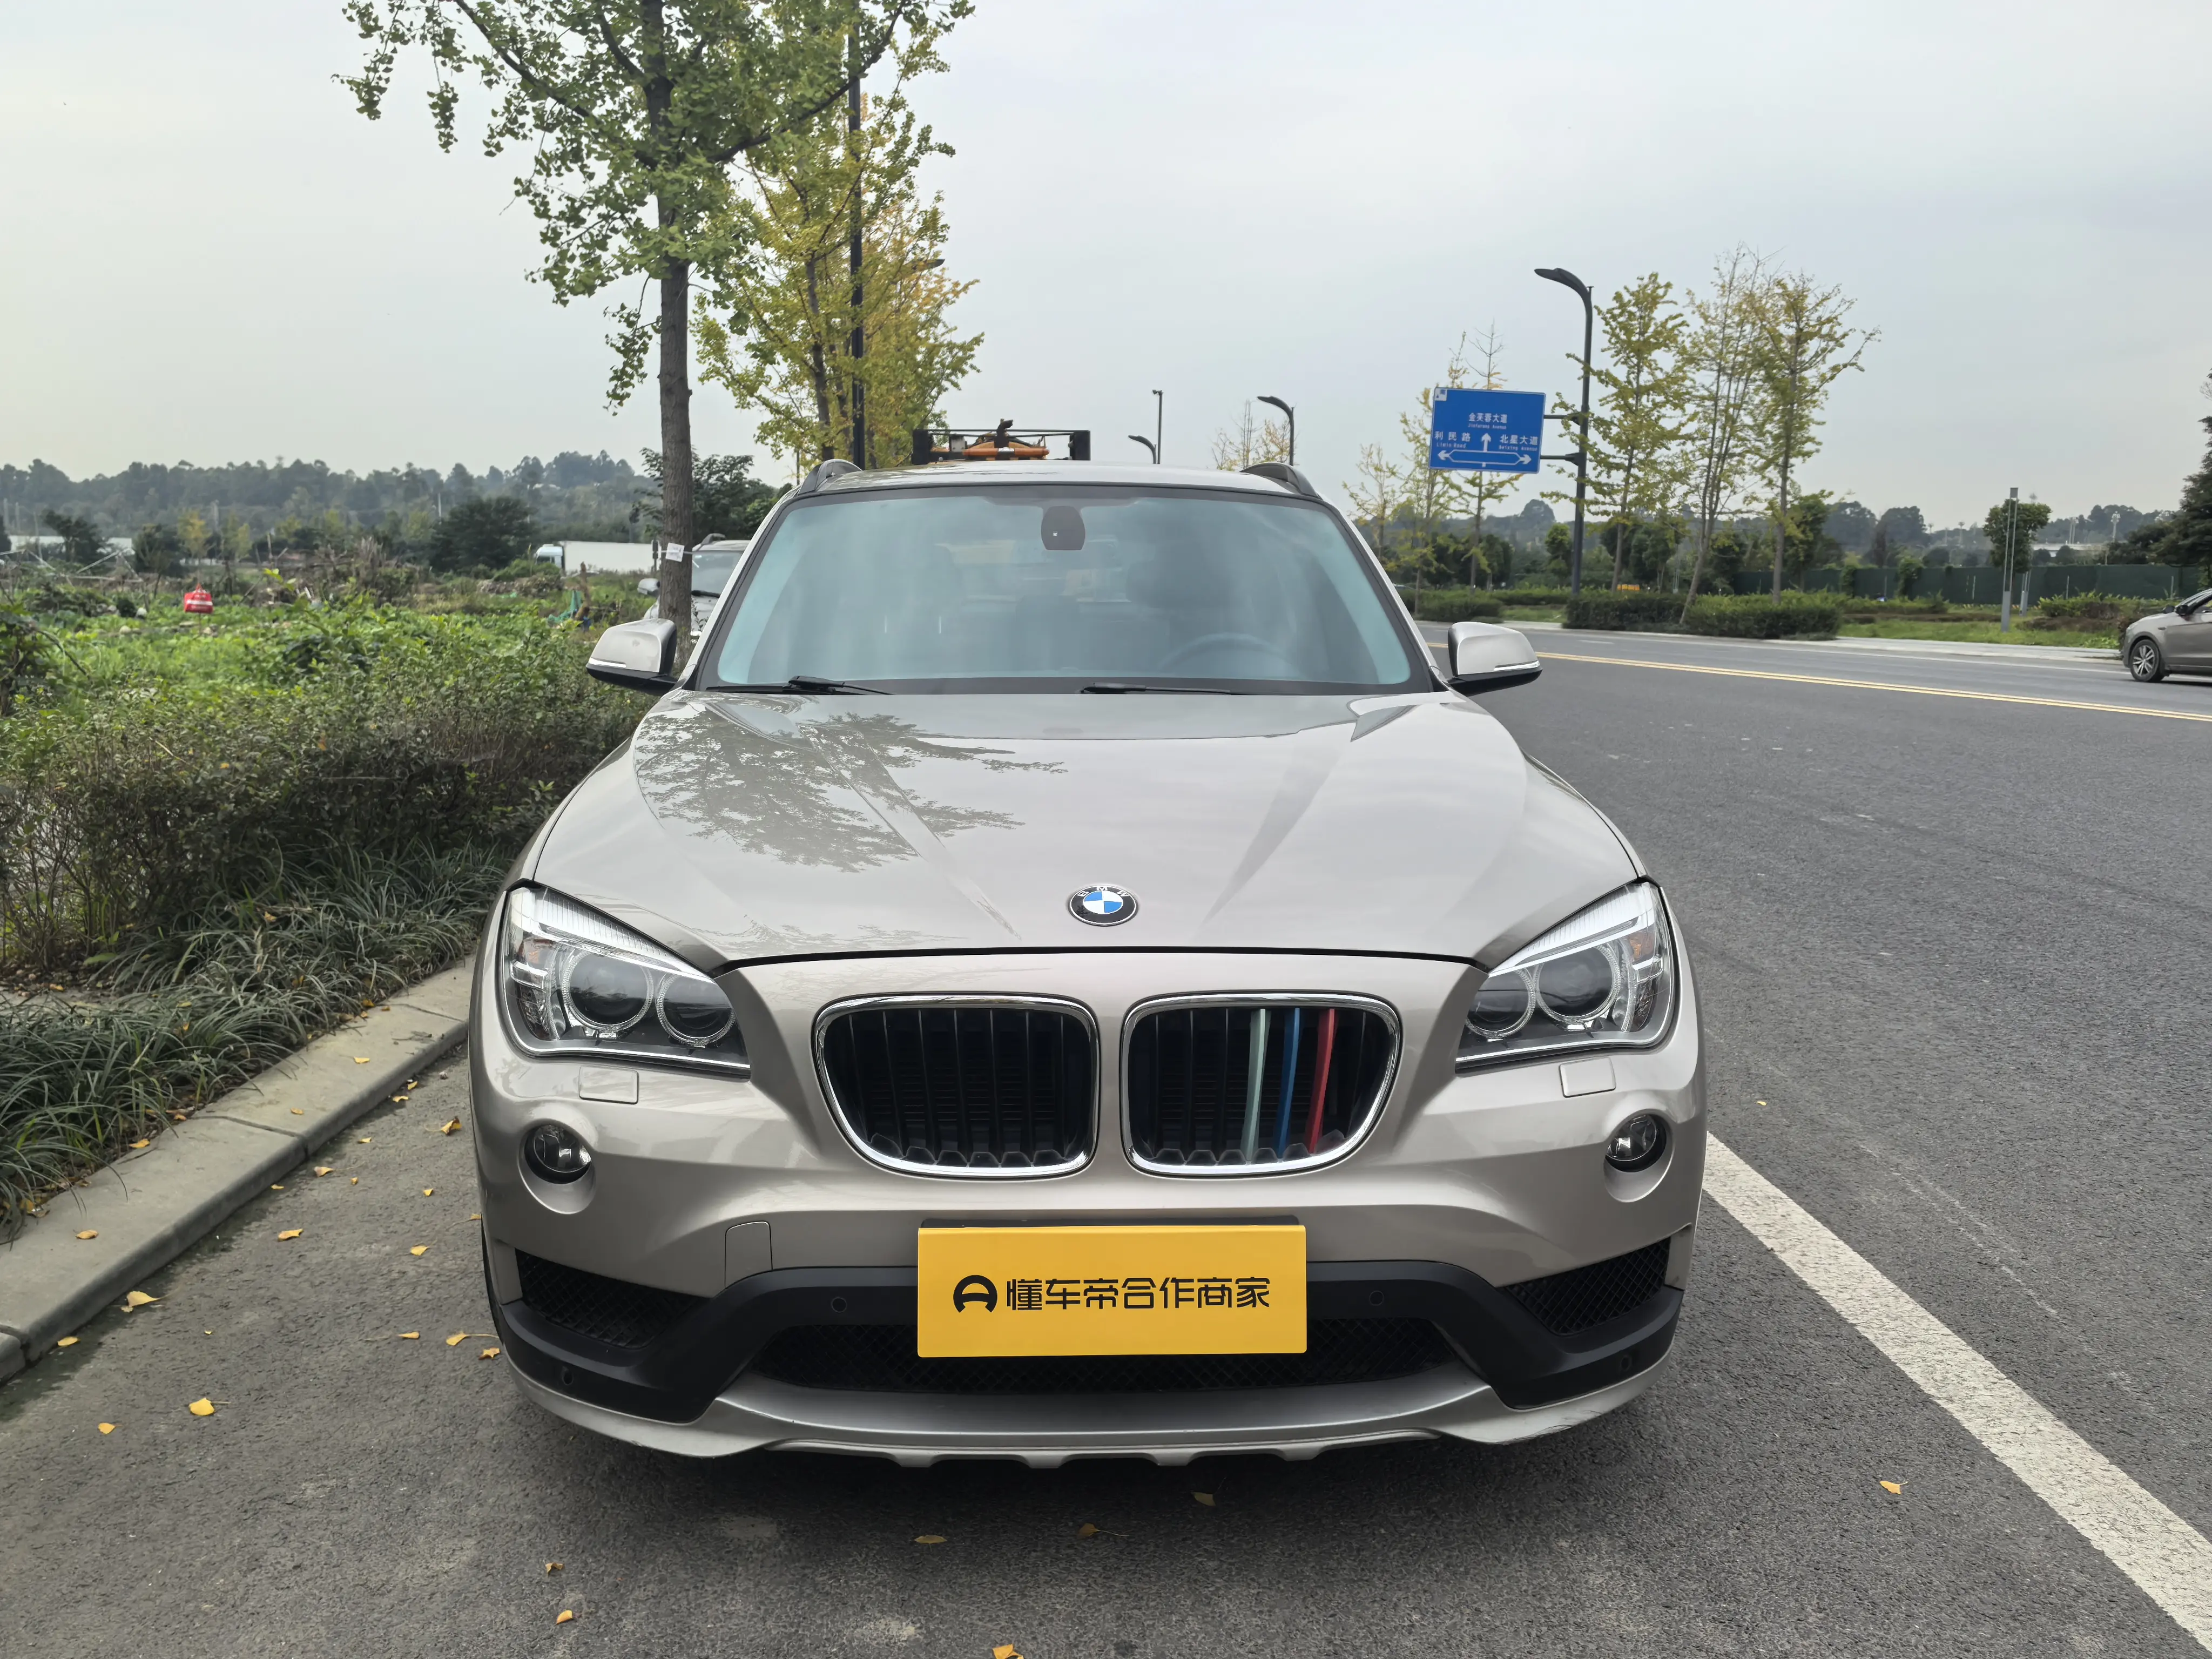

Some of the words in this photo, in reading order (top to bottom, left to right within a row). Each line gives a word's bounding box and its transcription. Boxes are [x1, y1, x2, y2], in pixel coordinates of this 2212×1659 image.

[1434, 431, 1471, 442] 利民路
[1499, 434, 1538, 446] 北星大道
[1076, 886, 1130, 897] BMW
[1006, 1276, 1270, 1311] 懂车帝合作商家
